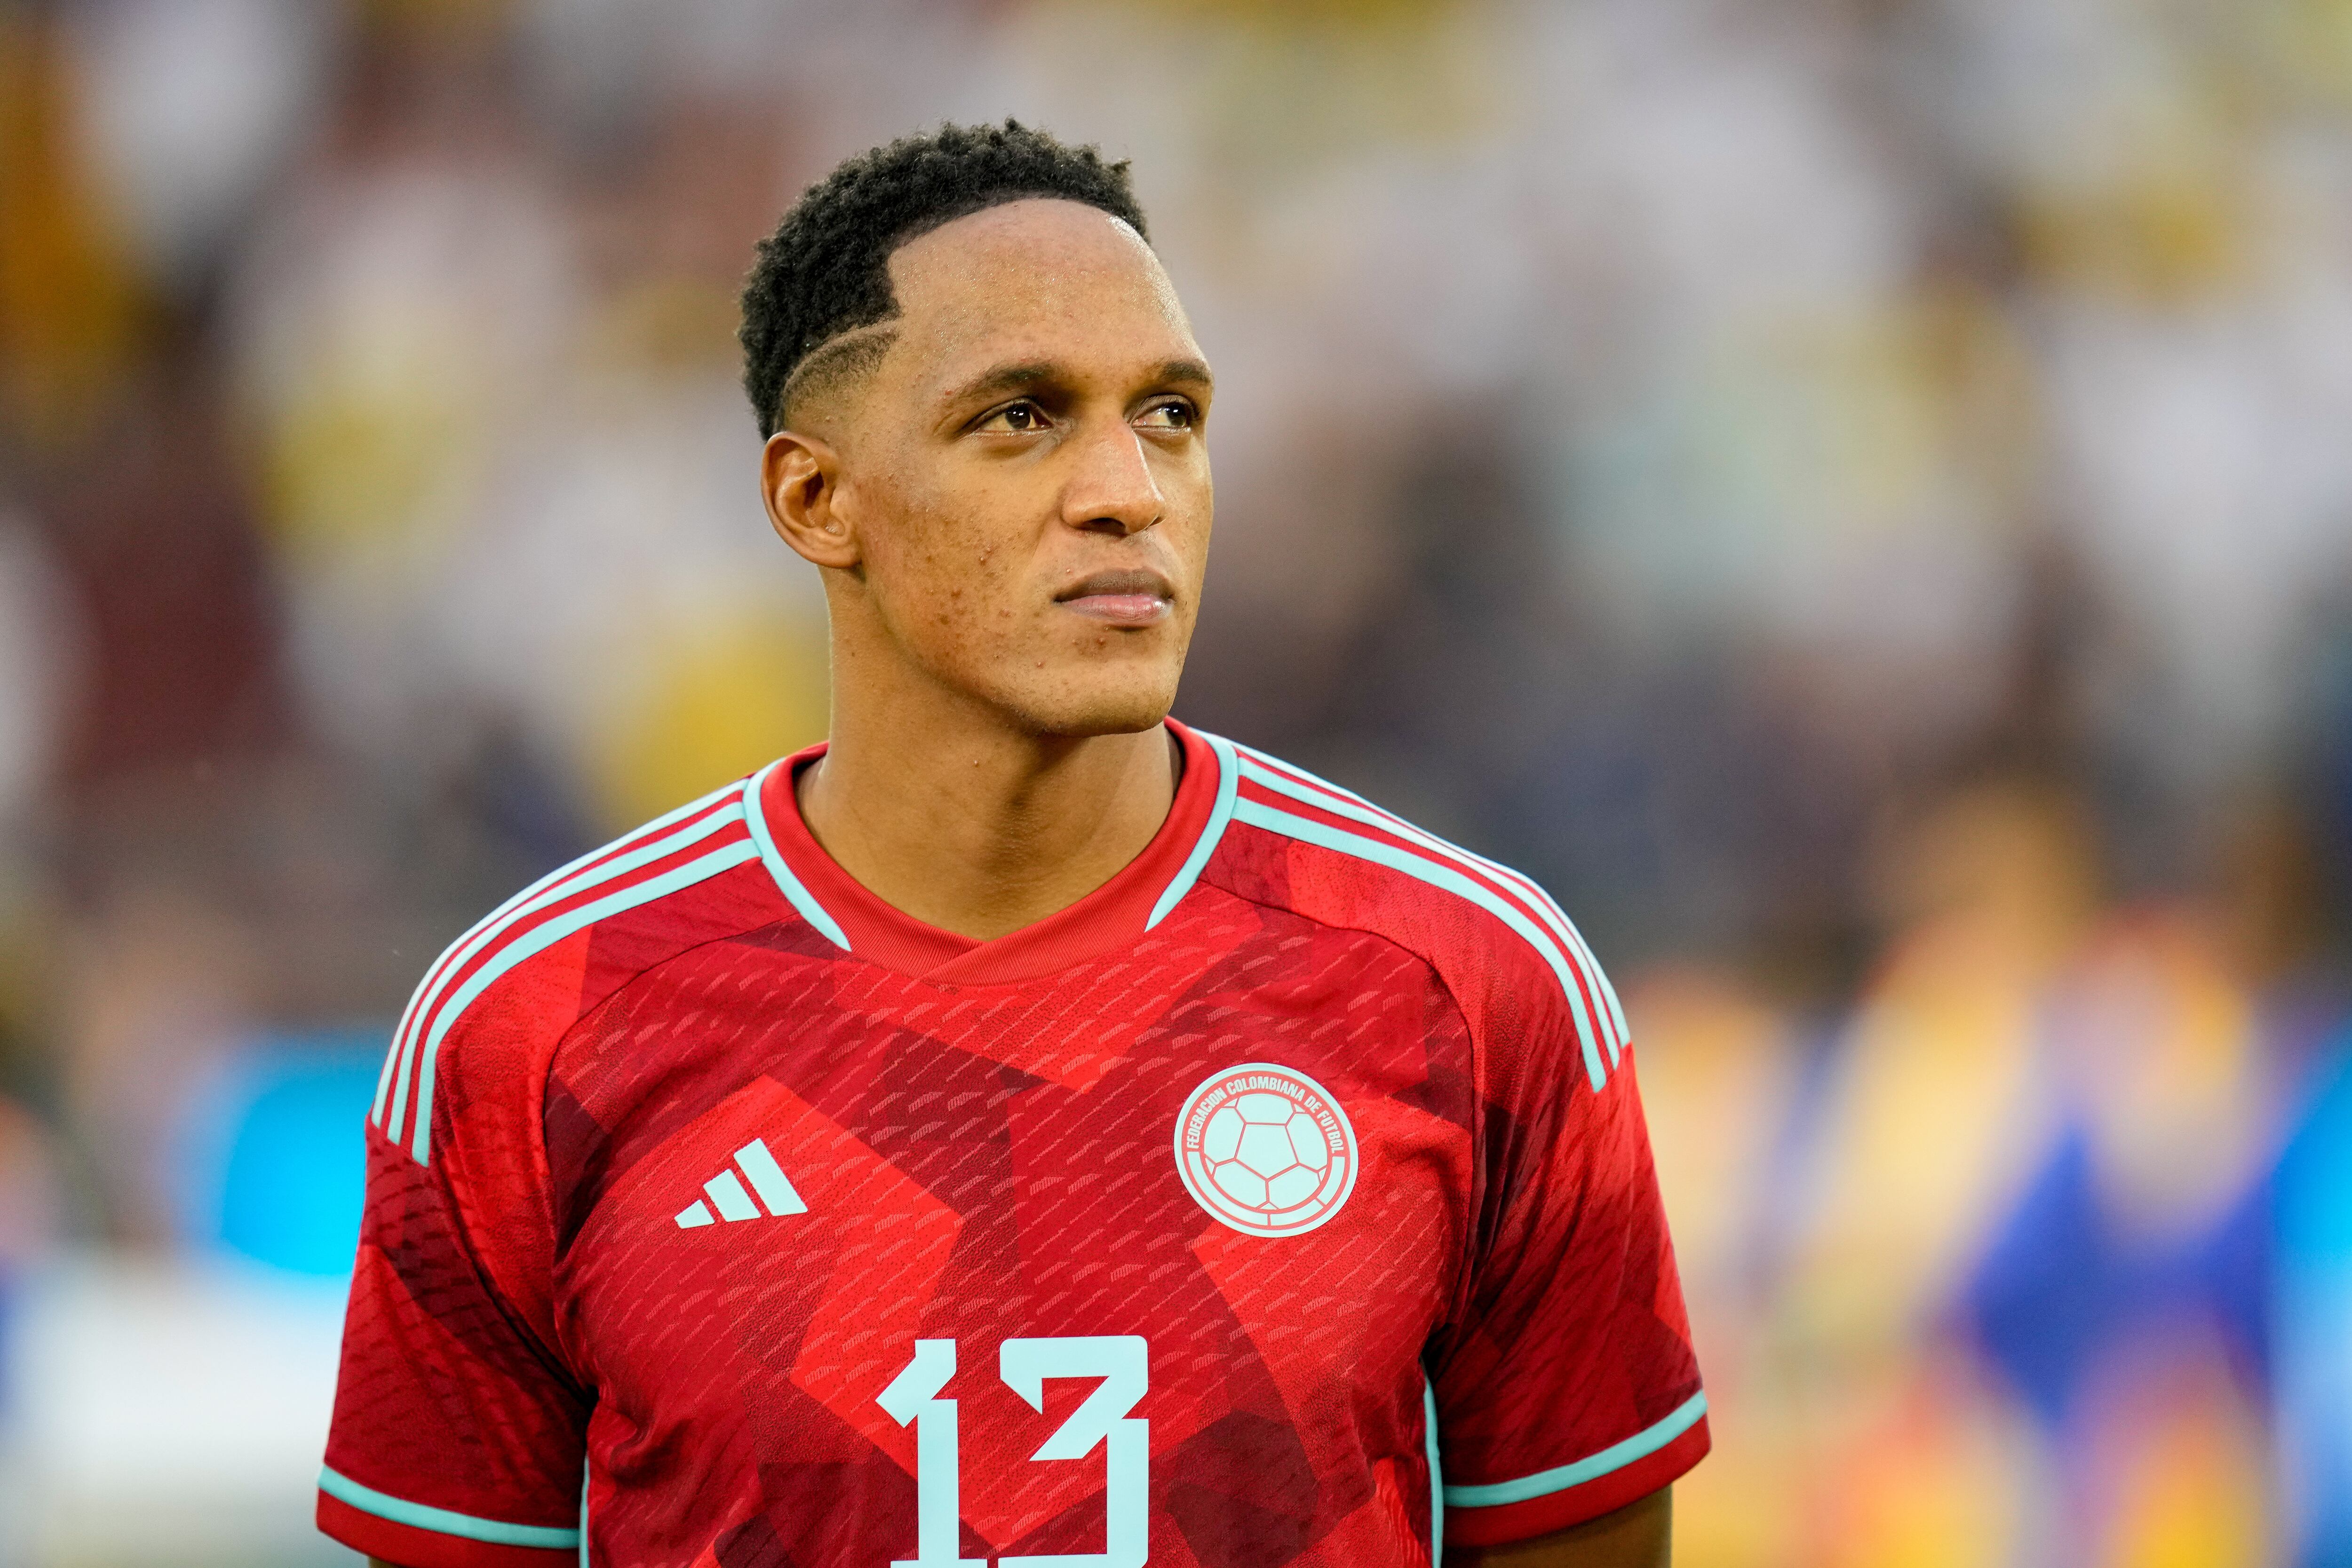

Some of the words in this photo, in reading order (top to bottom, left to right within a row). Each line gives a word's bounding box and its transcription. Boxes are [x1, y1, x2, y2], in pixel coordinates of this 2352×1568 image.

[1186, 1087, 1227, 1149] FEDERACION
[1226, 1076, 1305, 1102] COLOMBIANA
[1303, 1095, 1322, 1114] DE
[1317, 1110, 1344, 1154] FUTBOL
[875, 1336, 1149, 1568] 13
